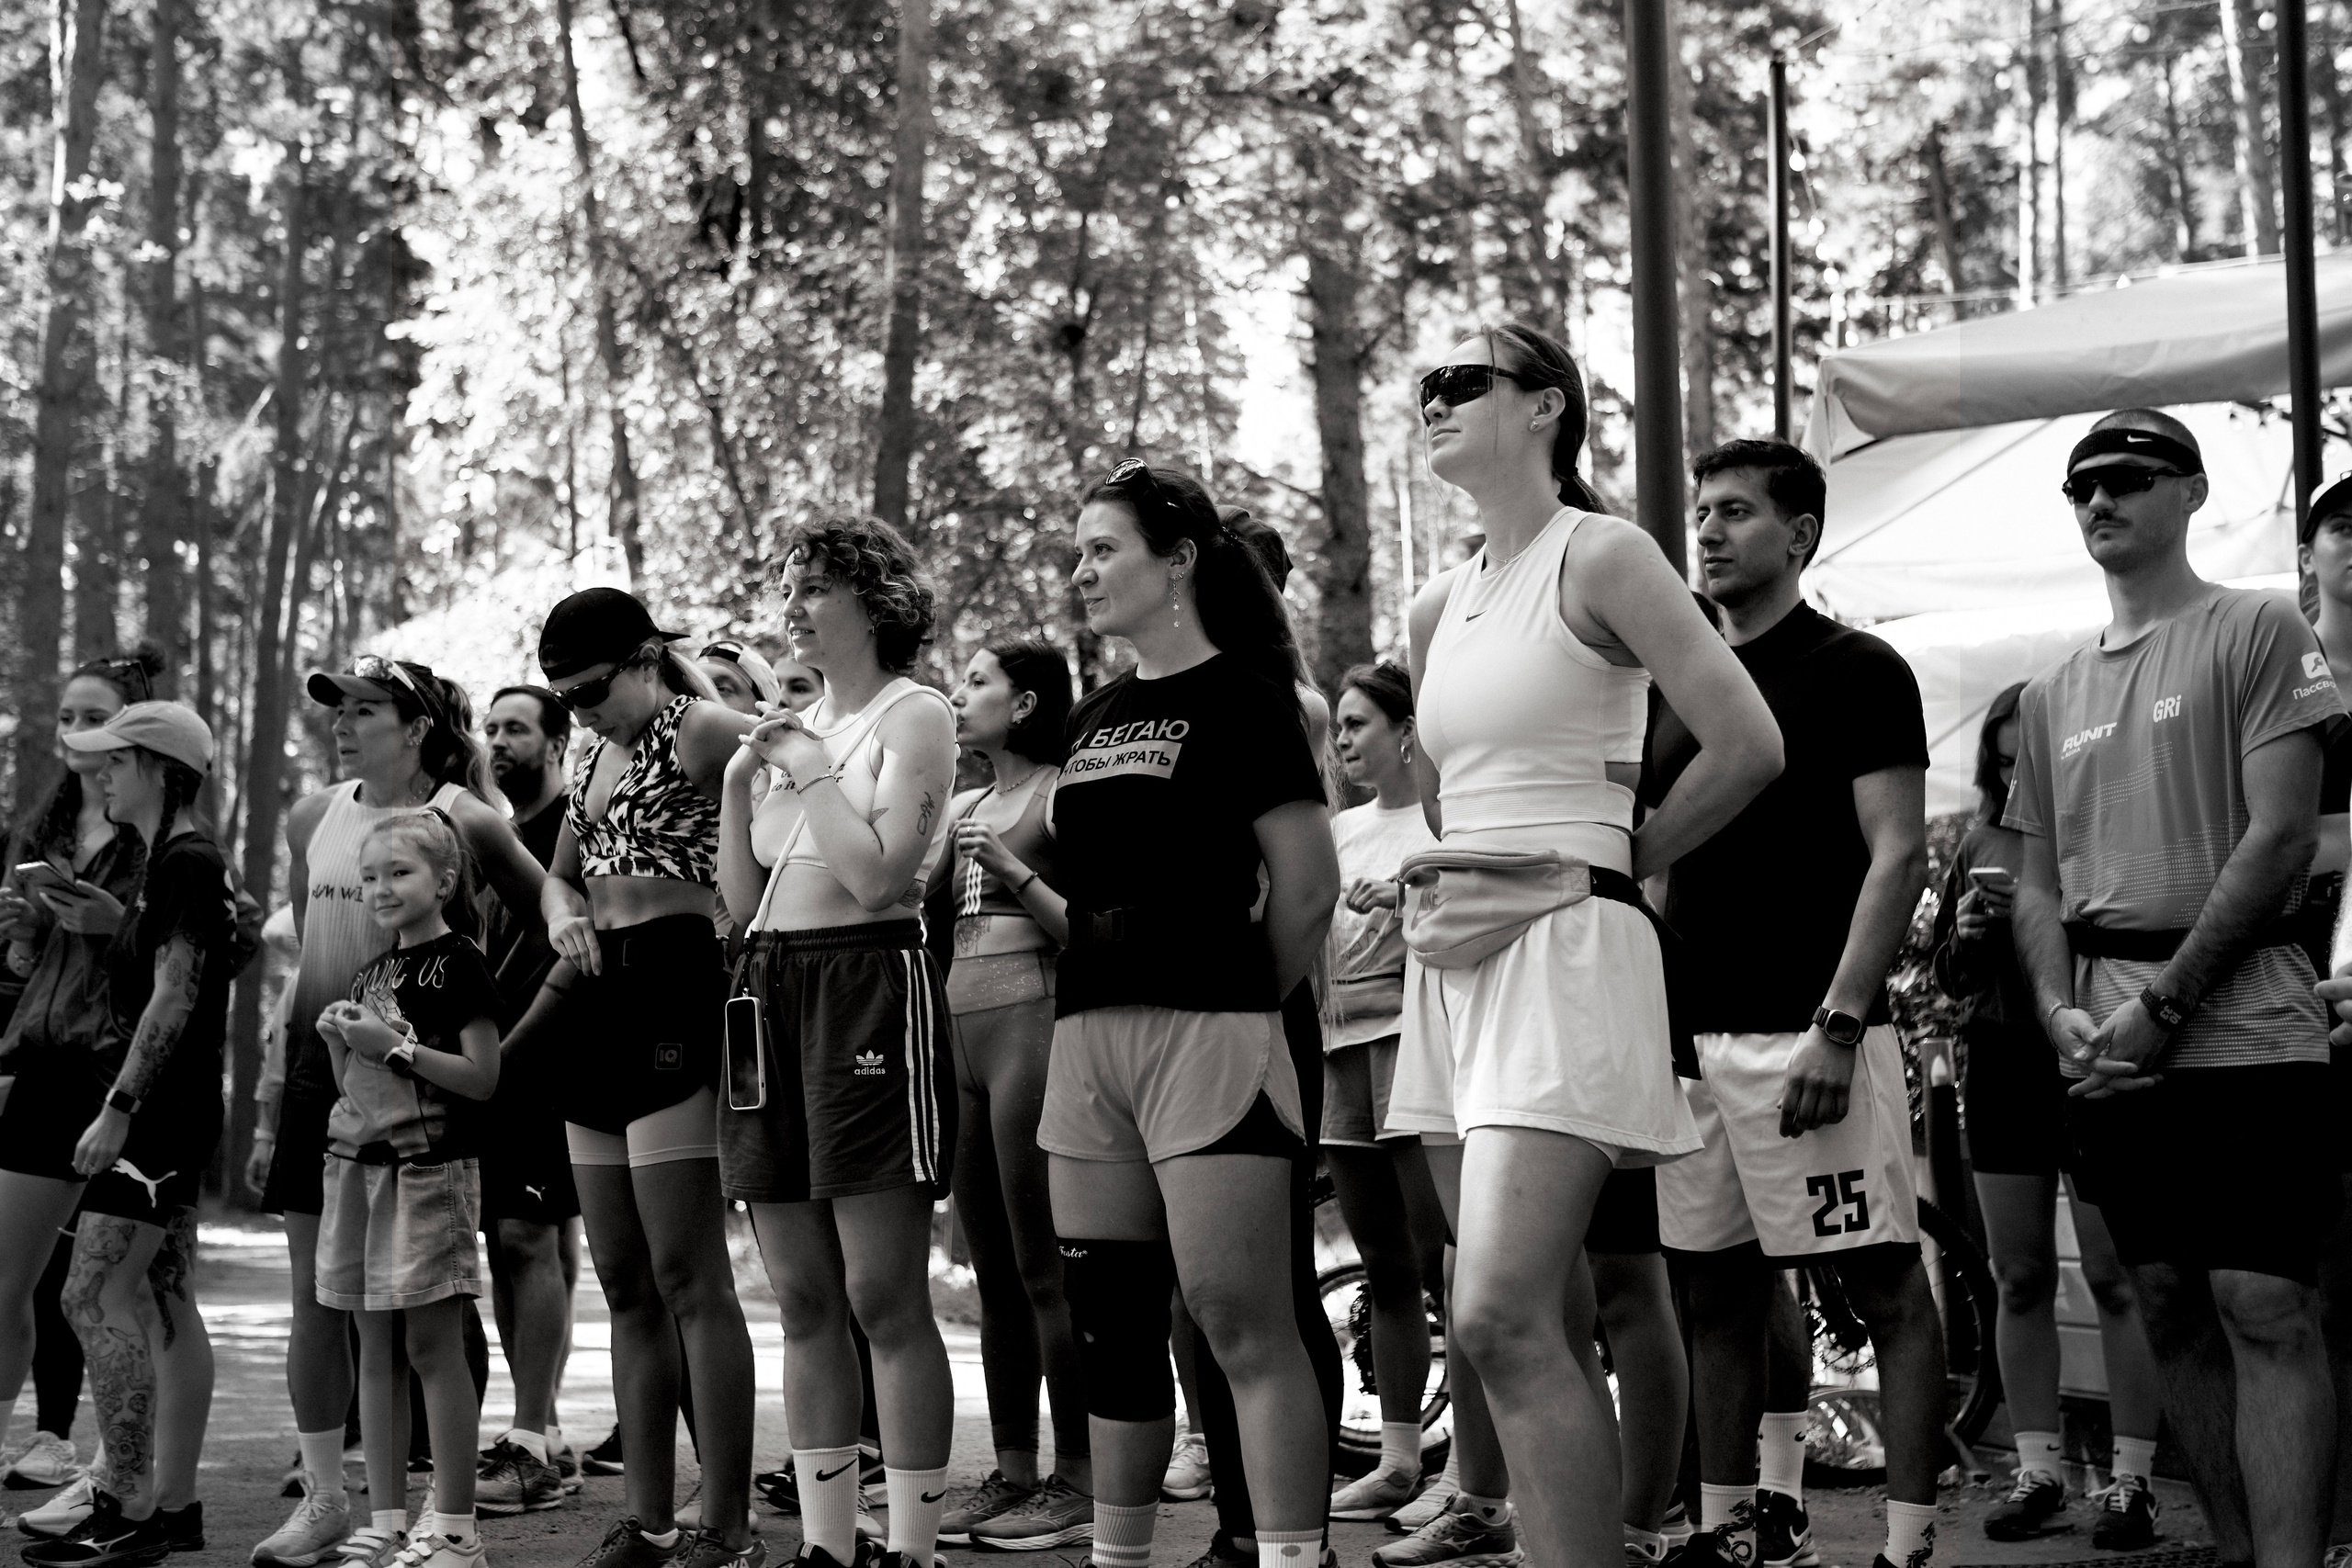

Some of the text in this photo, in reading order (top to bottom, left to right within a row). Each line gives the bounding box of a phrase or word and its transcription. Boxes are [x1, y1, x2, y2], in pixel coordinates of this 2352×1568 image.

[1088, 719, 1190, 748] БЕГАЮ
[2062, 722, 2118, 753] RUNIT
[1112, 750, 1171, 767] ЖРАТЬ
[418, 955, 449, 988] US
[854, 1066, 887, 1076] adidas
[1805, 1168, 1871, 1237] 25
